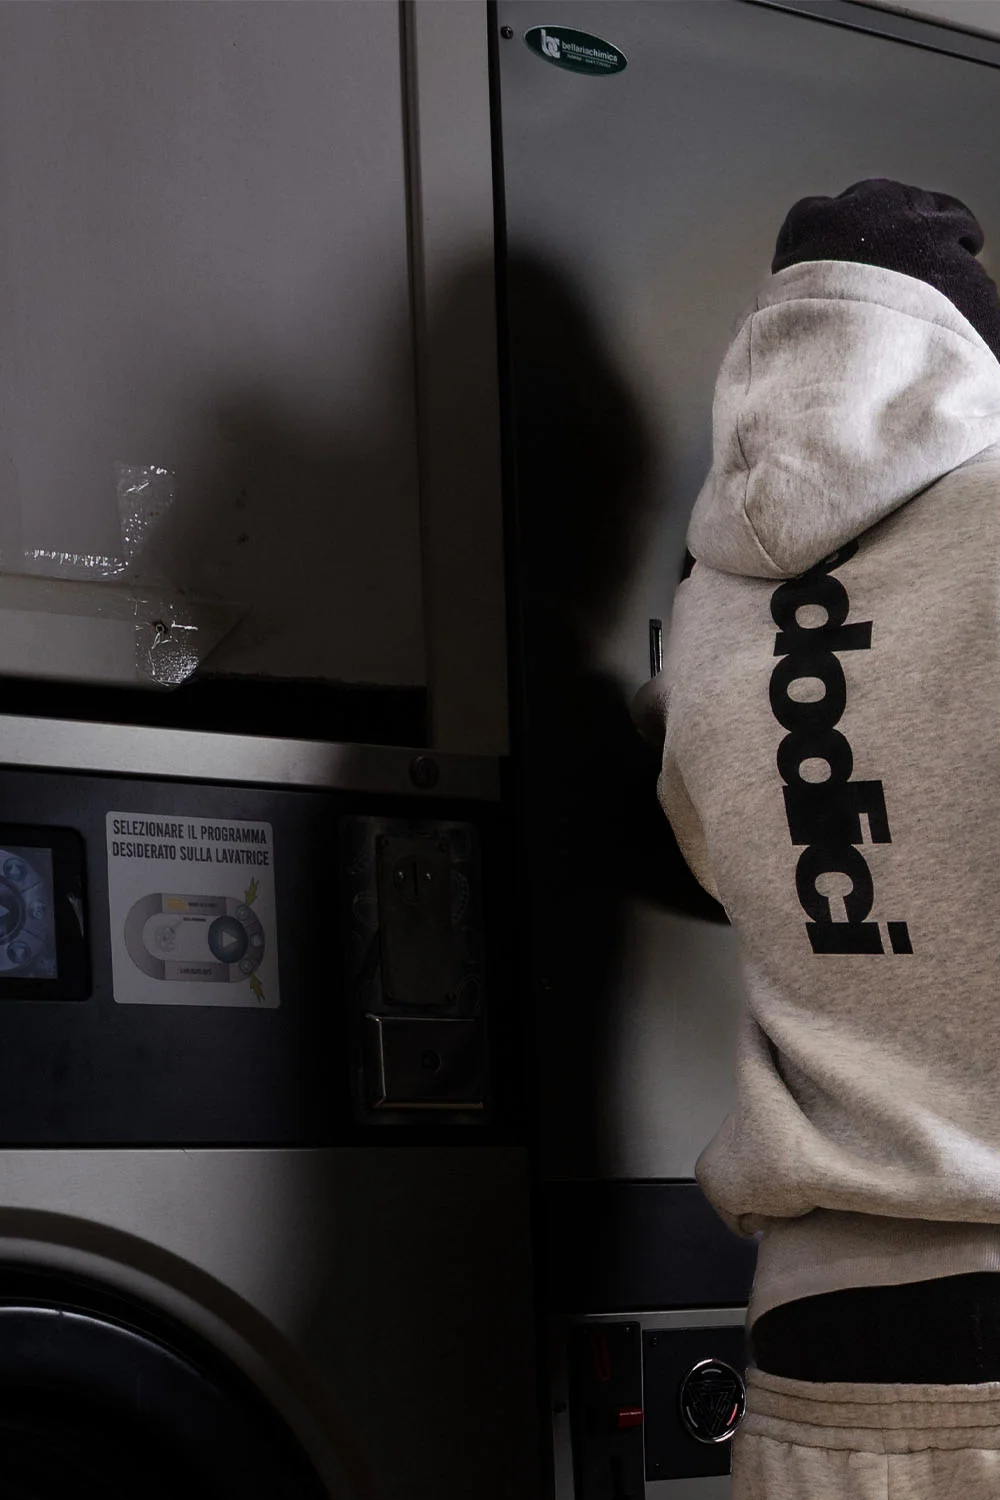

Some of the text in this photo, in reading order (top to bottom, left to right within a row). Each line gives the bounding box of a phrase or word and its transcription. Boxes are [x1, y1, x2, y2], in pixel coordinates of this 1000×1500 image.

[562, 40, 618, 63] bellariachimica
[769, 538, 914, 954] dodici
[113, 819, 267, 844] SELEZIONARE IL PROGRAMMA
[112, 842, 269, 866] DESIDERATO SULLA LAVATRICE
